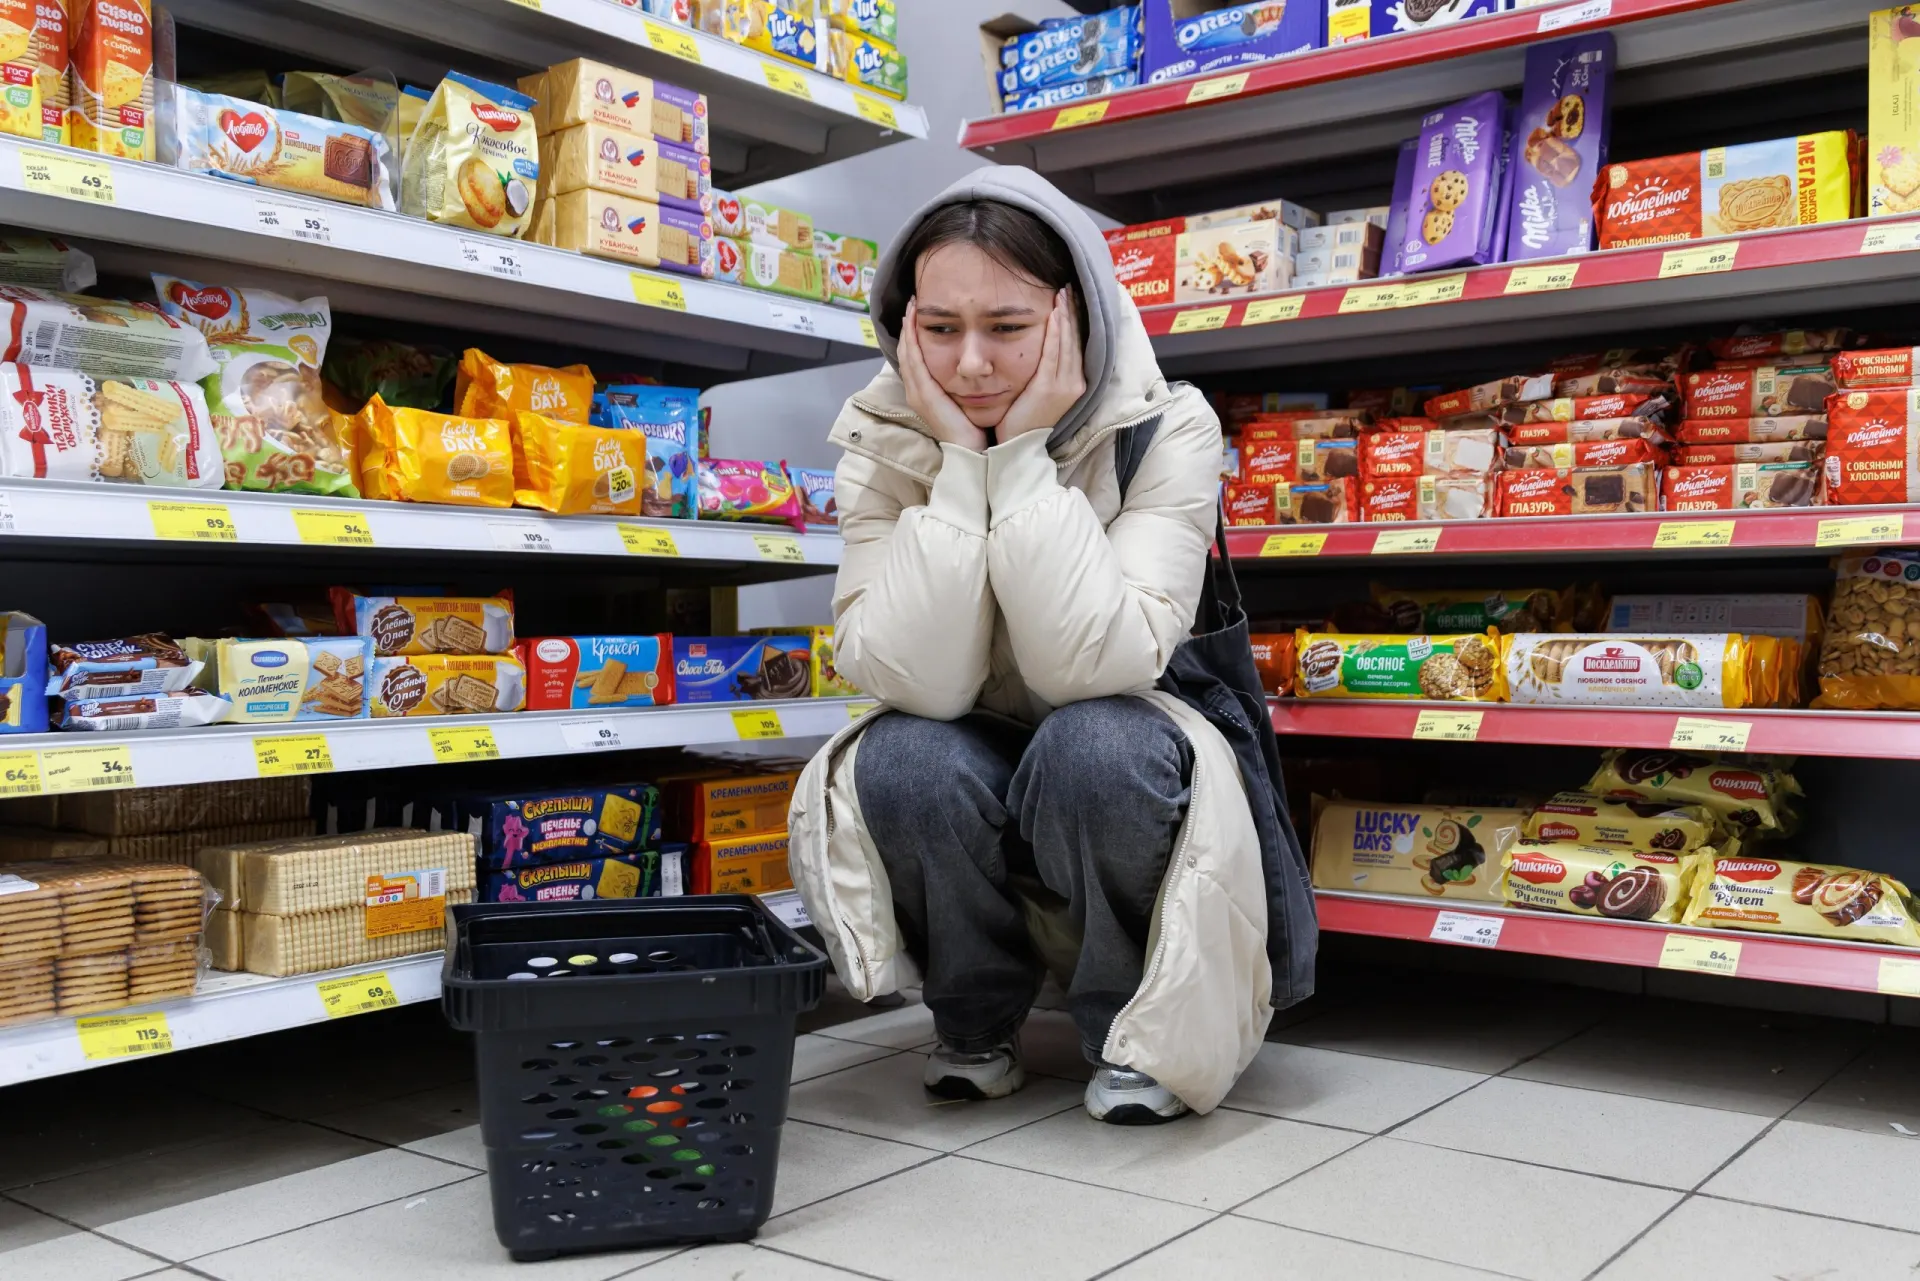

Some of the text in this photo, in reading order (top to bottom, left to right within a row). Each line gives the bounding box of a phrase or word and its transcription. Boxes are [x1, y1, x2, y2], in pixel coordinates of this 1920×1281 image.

[98, 1, 143, 23] Cristo
[98, 14, 144, 36] Twisto
[1178, 9, 1243, 46] OREO
[110, 41, 141, 55] сыром
[1022, 25, 1082, 60] OREO
[6, 66, 29, 78] ГОСТ
[1020, 48, 1079, 82] OREO
[1149, 60, 1197, 84] OREO
[1023, 81, 1085, 112] OREO
[122, 108, 142, 119] ГОСТ
[593, 110, 632, 125] КУБАНОЧКА
[226, 118, 266, 142] Любятово
[466, 122, 528, 156] Кокосовое
[1455, 115, 1481, 165] Milka
[1797, 139, 1816, 189] МЕГА
[26, 172, 51, 181] -20%
[82, 176, 101, 188] 49
[599, 169, 638, 184] КУБАНОЧКА
[1607, 186, 1690, 220] Юбилейное
[259, 217, 280, 225] -40%
[1520, 184, 1549, 249] Milka
[1631, 210, 1655, 225] 1913
[304, 219, 320, 230] 59
[600, 239, 639, 252] КУБАНОЧКА
[1610, 232, 1691, 250] ТРАДИЦИОННОЕ
[499, 256, 514, 266] 79
[1710, 254, 1727, 264] 89
[1547, 275, 1566, 283] 169
[1376, 293, 1394, 301] 169
[1437, 284, 1456, 295] 169
[180, 291, 229, 311] Любятово
[1859, 353, 1909, 366] ОВСЯНЫМИ
[1857, 364, 1905, 376] ХЛОПЬЯМИ
[532, 378, 560, 394] Lucky
[1694, 381, 1746, 399] Юбилейное
[530, 392, 568, 410] DAYS
[1696, 405, 1737, 417] ГЛАЗУРЬ
[441, 420, 476, 440] Lucky
[1519, 428, 1549, 438] ГЛАЗУРЬ
[1698, 427, 1730, 436] ГЛАЗУРЬ
[1846, 425, 1904, 444] Юбилейное
[443, 436, 487, 454] DAYS
[593, 437, 621, 455] Lucky
[1373, 440, 1420, 458] Юбилейное
[593, 450, 626, 472] DAYS
[1249, 451, 1292, 468] Юбилейное
[1685, 454, 1716, 464] ГЛАЗУРЬ
[1853, 460, 1904, 471] ОВСЯНЫМИ
[1375, 463, 1412, 474] ГЛАЗУРЬ
[1850, 471, 1901, 482] ХЛОПЬЯМИ
[612, 480, 632, 493] -20%
[1508, 478, 1556, 496] Юбилейное
[1673, 476, 1727, 494] Юбилейное
[1232, 495, 1270, 511] Юбилейное
[1369, 490, 1413, 507] Юбилейное
[1676, 501, 1718, 511] ГЛАЗУРЬ
[1509, 501, 1556, 515] ГЛАЗУРЬ
[206, 518, 224, 530] 89
[344, 524, 361, 535] 94
[524, 533, 543, 542] 109
[655, 539, 668, 547] 39
[371, 615, 416, 636] Хлебный
[76, 639, 125, 652] СУПЕР
[379, 627, 409, 651] Спас
[592, 637, 640, 664] Крокет
[677, 659, 702, 675] Choco
[1356, 656, 1406, 671] ОВСЯНОЕ
[1585, 658, 1639, 670] Посиделкино
[258, 675, 284, 683] Печенье
[383, 673, 428, 695] Хлебный
[1615, 677, 1648, 685] ОВСЯНОЕ
[238, 679, 299, 697] КОЛОМЕНСКОЕ
[388, 687, 421, 712] Спас
[760, 721, 775, 729] 109
[598, 728, 612, 738] 69
[1718, 735, 1736, 744] 74
[474, 739, 489, 748] 34
[305, 749, 321, 760] 27
[102, 761, 123, 773] 34
[5, 769, 28, 781] 64
[710, 780, 790, 800] КРЕМЕНКУЛЬСКОЕ
[522, 796, 594, 820] СКРЕПЫШИ
[540, 817, 582, 833] ПЕЧЕНЬЕ
[1355, 810, 1421, 835] LUCKY
[545, 830, 576, 840] САХАРНОЕ
[1541, 825, 1577, 838] Яшкино
[1353, 834, 1392, 852] DAYS
[1511, 860, 1563, 876] Яшкино
[1715, 859, 1777, 873] Яшкино
[519, 863, 591, 888] СКРЕПЫШИ
[536, 885, 579, 901] ПЕЧЕНЬЕ
[1508, 879, 1564, 899] бисквитный
[1514, 889, 1557, 906] Рулет
[1476, 927, 1492, 936] 49
[1709, 950, 1727, 961] 84
[368, 987, 383, 998] 69
[136, 1028, 159, 1041] 119
